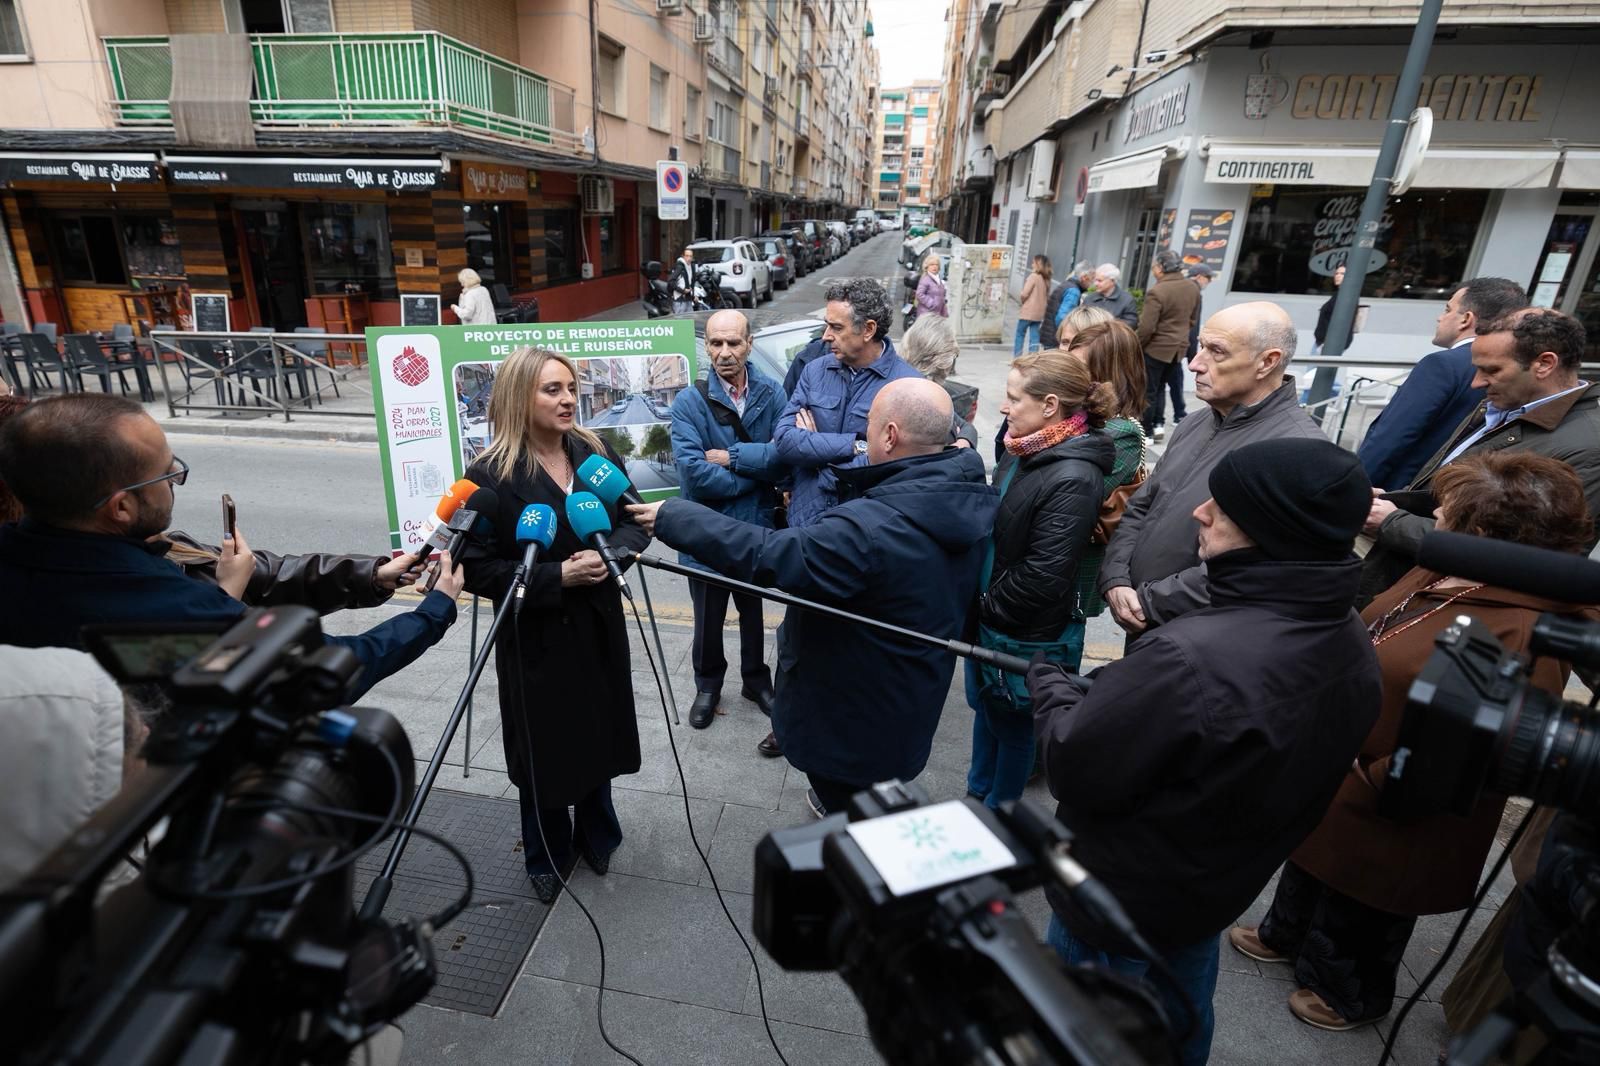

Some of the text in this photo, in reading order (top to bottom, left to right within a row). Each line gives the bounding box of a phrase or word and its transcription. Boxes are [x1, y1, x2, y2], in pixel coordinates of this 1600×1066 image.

[26, 165, 69, 176] RESTAURANTE
[1217, 161, 1315, 179] CONTINENTAL
[293, 172, 342, 183] RESTAURANTE
[463, 325, 674, 342] PROYECTO DE REMODELACIÓN
[491, 344, 510, 355] DE
[584, 339, 653, 352] RUISEÑOR
[407, 407, 426, 415] PLAN
[430, 406, 442, 427] 2027
[391, 408, 404, 430] 2024
[405, 417, 430, 427] OBRAS
[395, 428, 442, 439] MUNICIPALES
[576, 501, 600, 511] TGT
